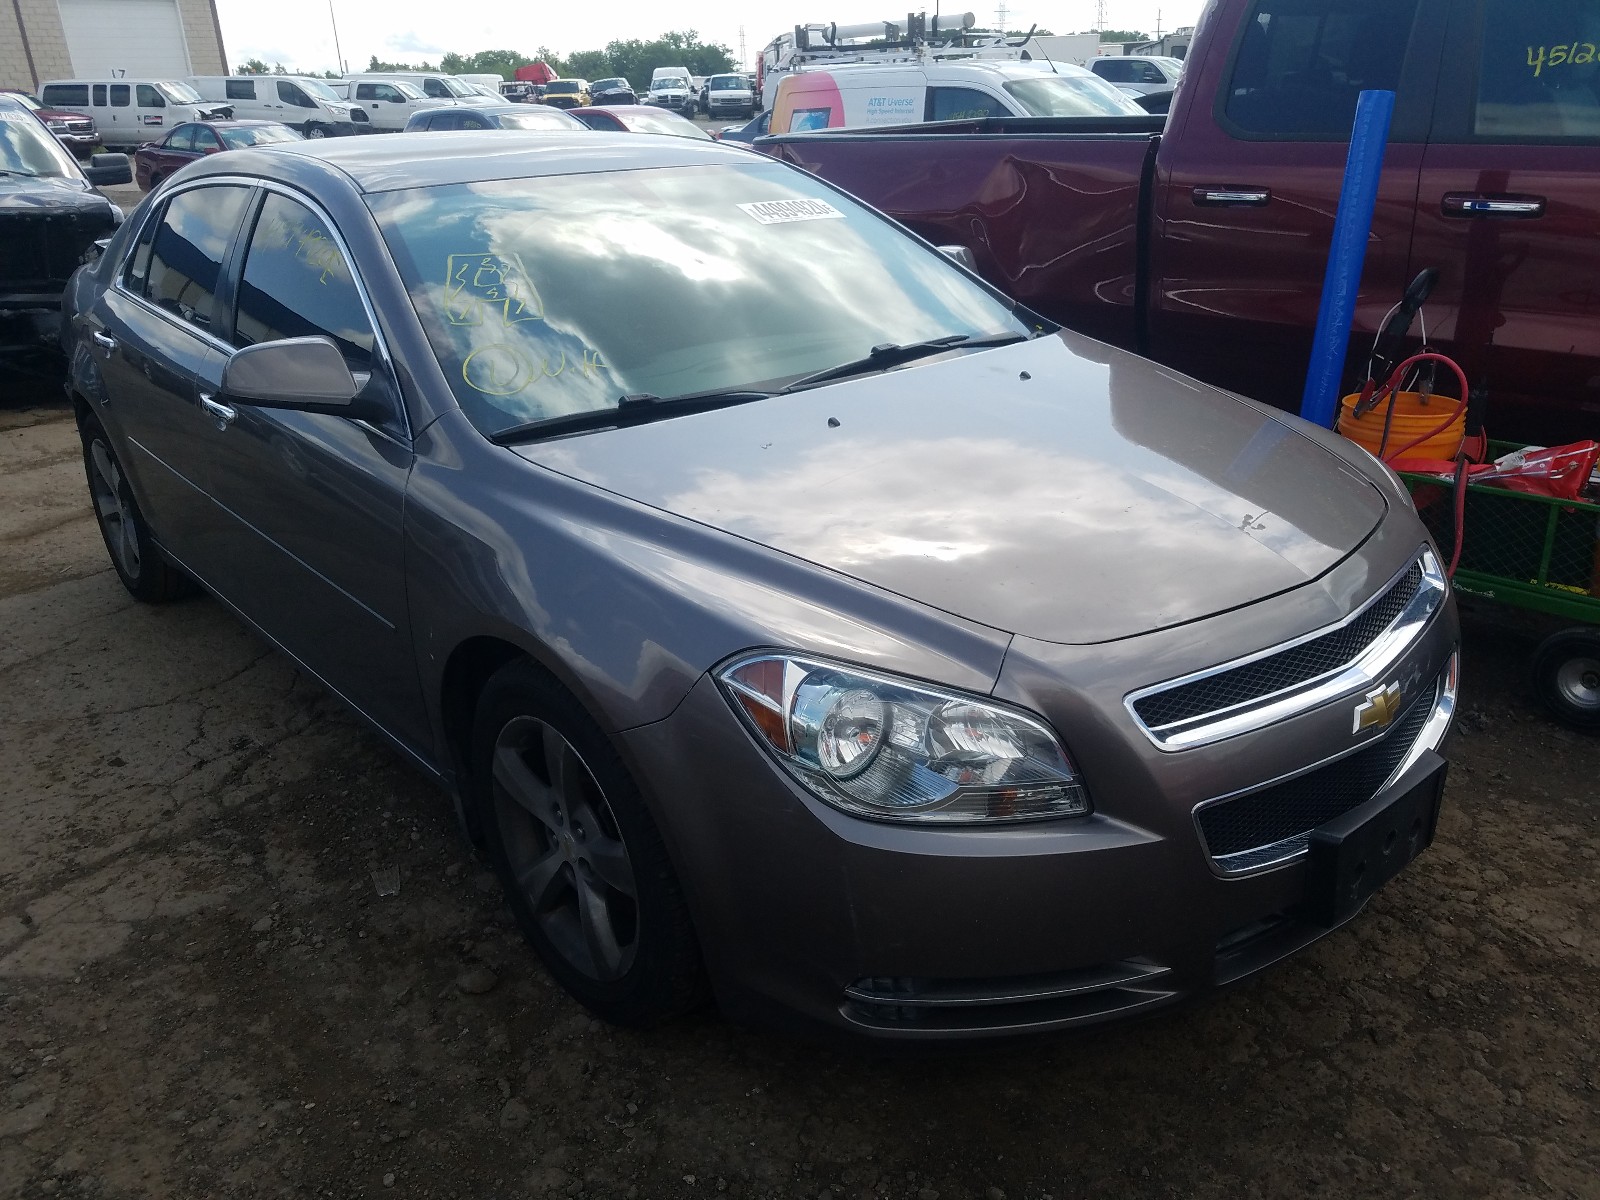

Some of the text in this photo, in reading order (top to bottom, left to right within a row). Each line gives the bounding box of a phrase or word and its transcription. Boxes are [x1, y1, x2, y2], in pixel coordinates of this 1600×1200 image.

[1527, 42, 1600, 77] 4512
[868, 97, 914, 107] AT&T U-verse
[878, 107, 894, 115] Speed
[894, 106, 915, 114] Internet
